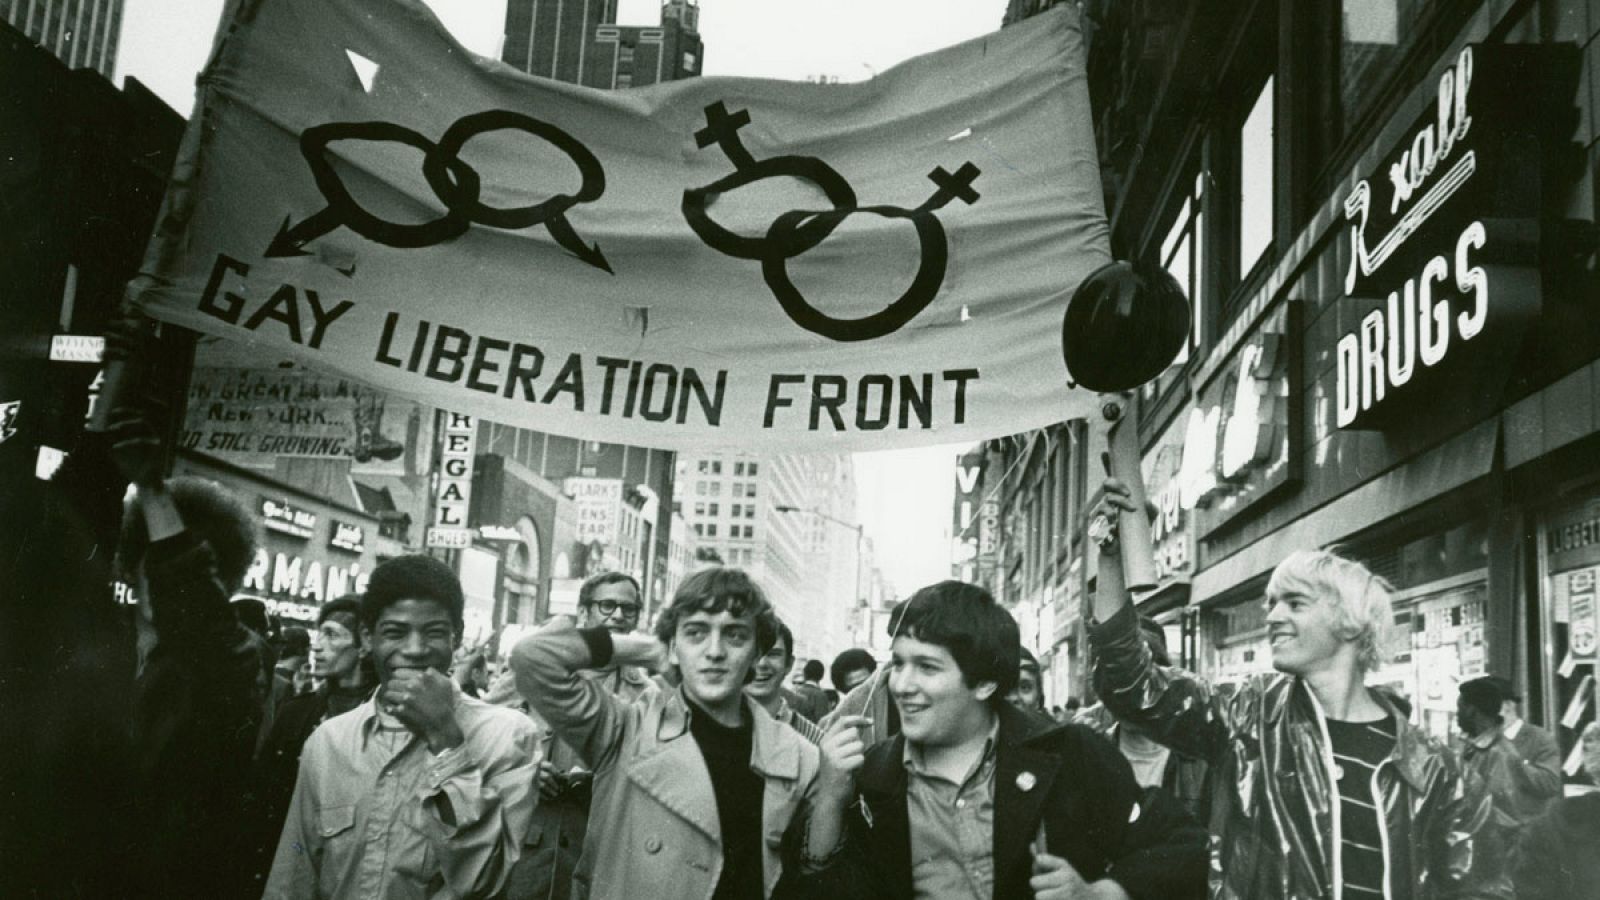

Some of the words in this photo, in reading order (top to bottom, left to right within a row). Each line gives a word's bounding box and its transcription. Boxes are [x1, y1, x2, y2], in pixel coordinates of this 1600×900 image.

[1344, 46, 1475, 296] Rxall
[197, 252, 355, 349] GAY
[375, 312, 728, 427] LIBERATION
[762, 368, 980, 431] FRONT
[1336, 220, 1488, 429] DRUGS
[206, 432, 252, 451] STILL
[208, 403, 252, 421] NEW
[440, 411, 471, 525] REGAL
